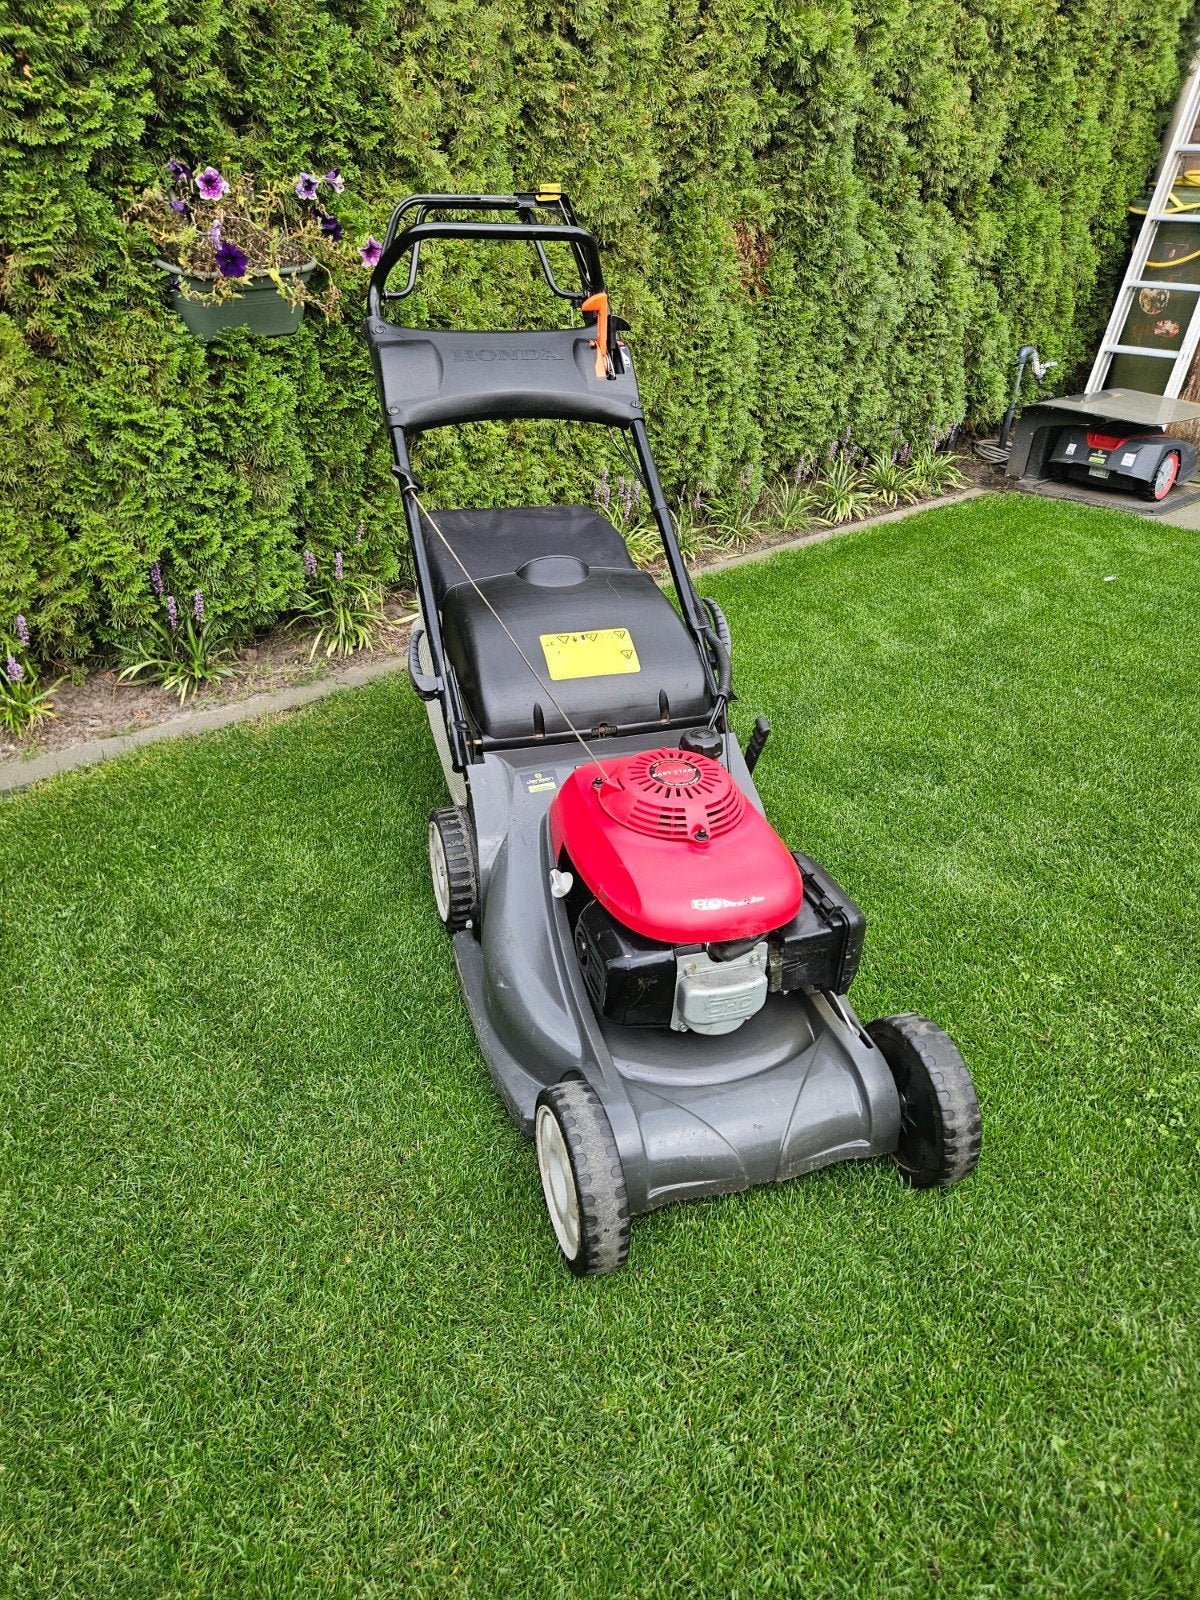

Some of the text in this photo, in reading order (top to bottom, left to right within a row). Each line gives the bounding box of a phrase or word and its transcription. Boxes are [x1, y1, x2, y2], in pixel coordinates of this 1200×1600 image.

[452, 348, 564, 362] HONDA
[652, 768, 698, 778] EASY START
